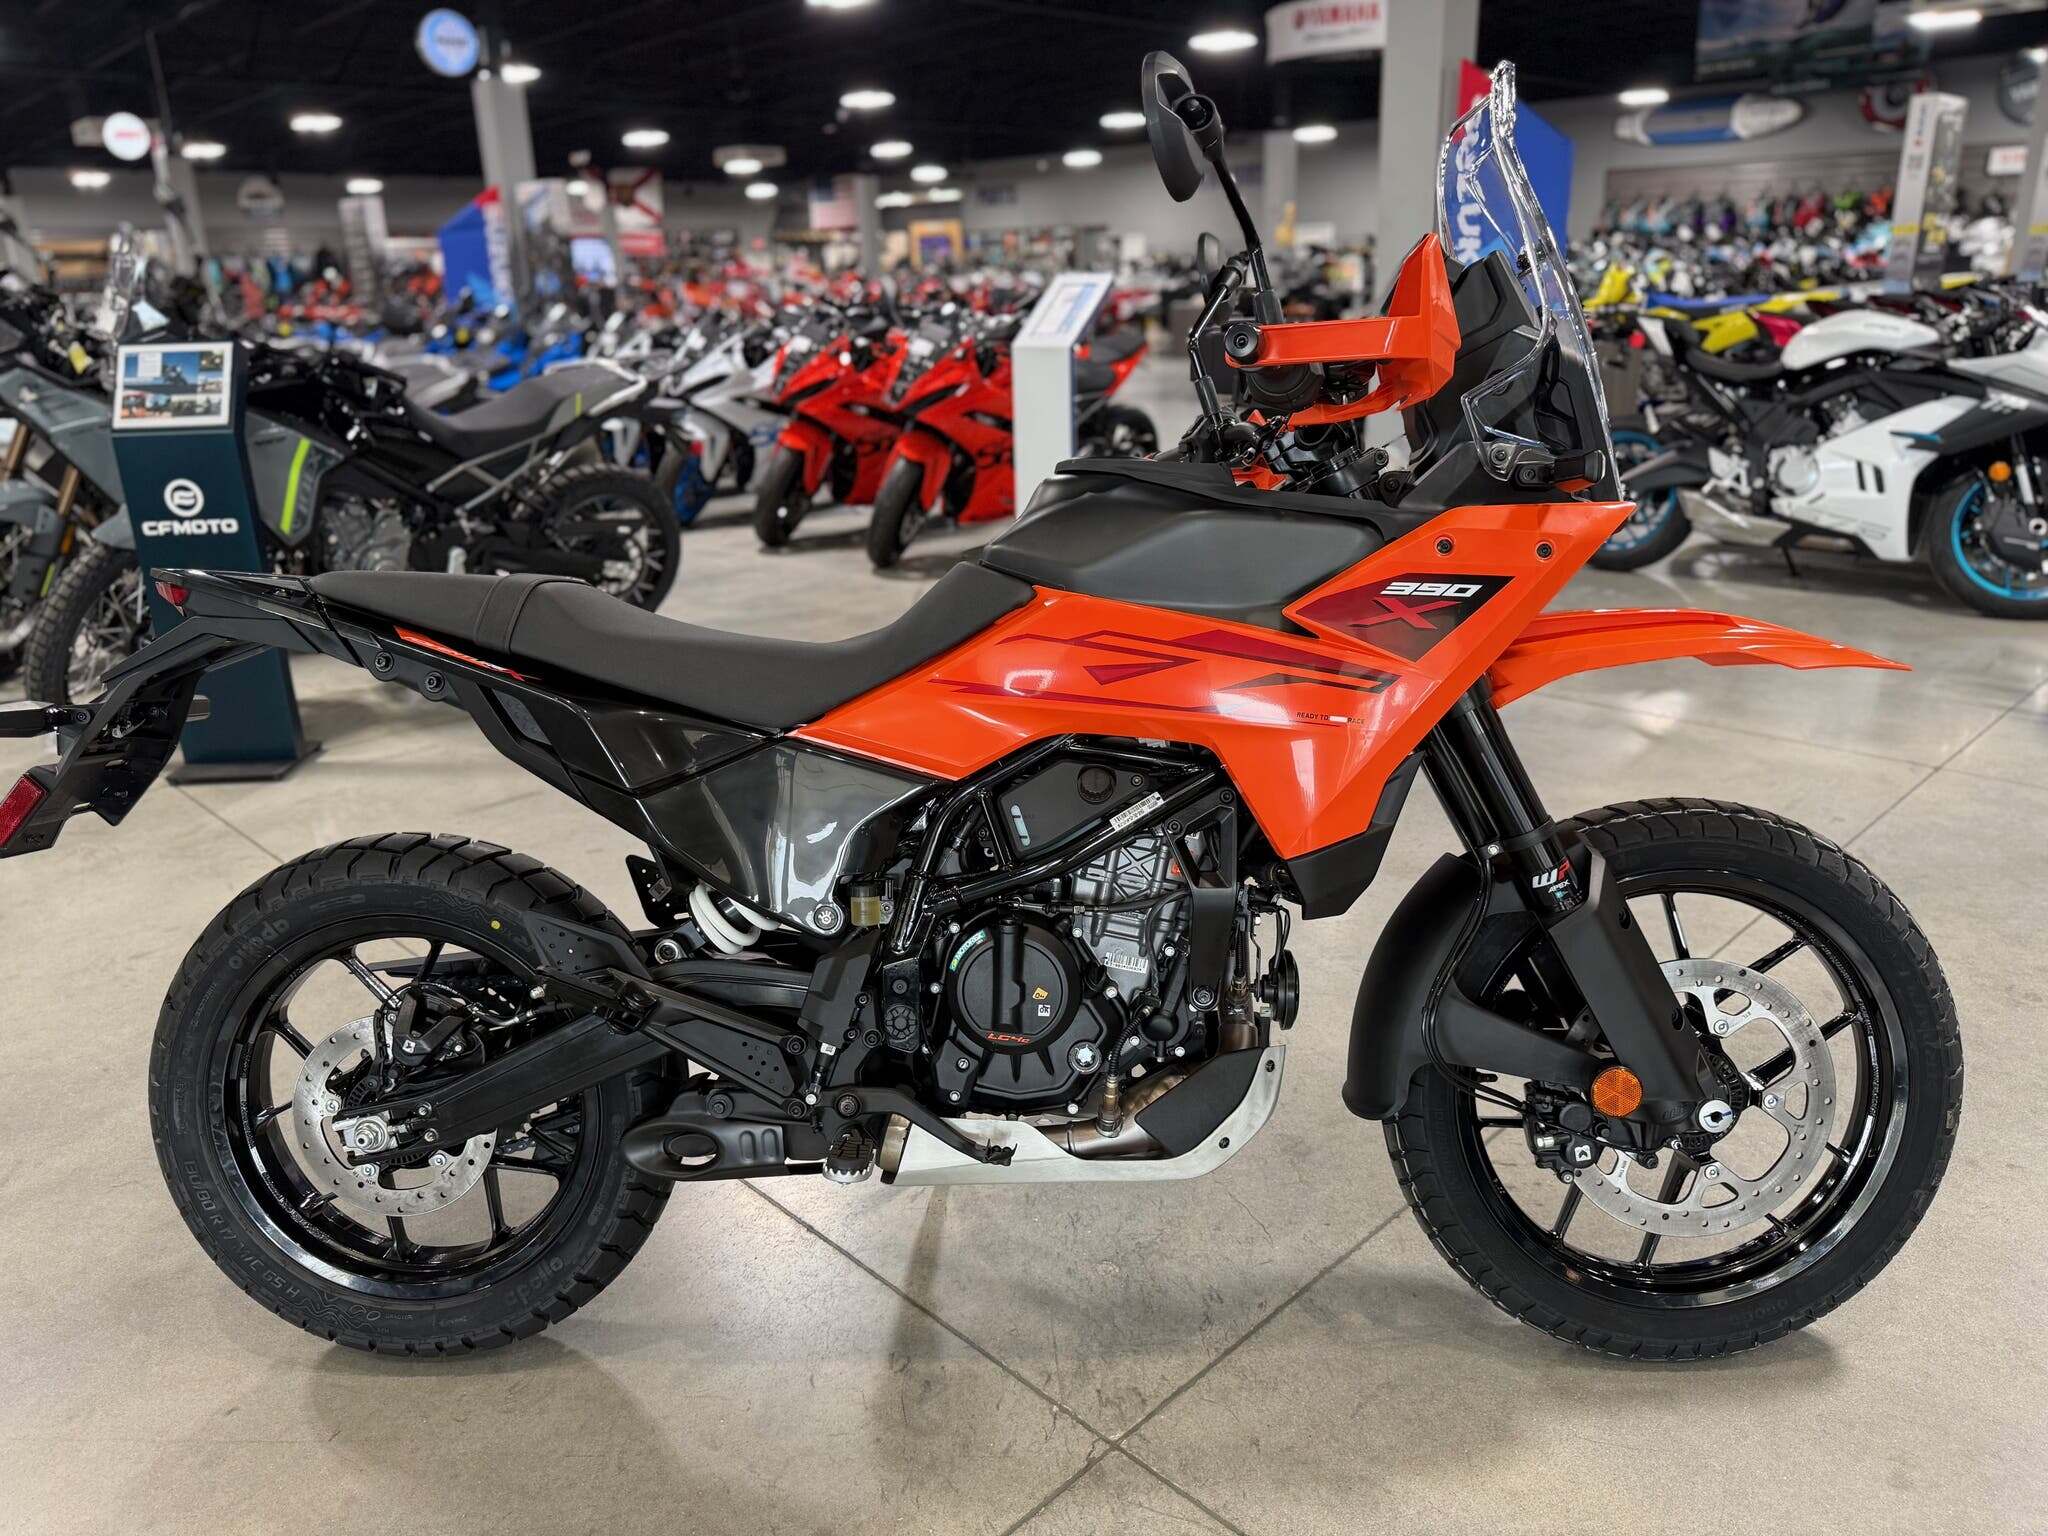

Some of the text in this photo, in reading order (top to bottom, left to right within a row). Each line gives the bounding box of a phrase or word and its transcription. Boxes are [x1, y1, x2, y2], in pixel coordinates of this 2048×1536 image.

[141, 517, 239, 537] CFMOTO
[1379, 581, 1483, 598] 390
[1296, 711, 1319, 720] READY
[1532, 856, 1570, 889] WP
